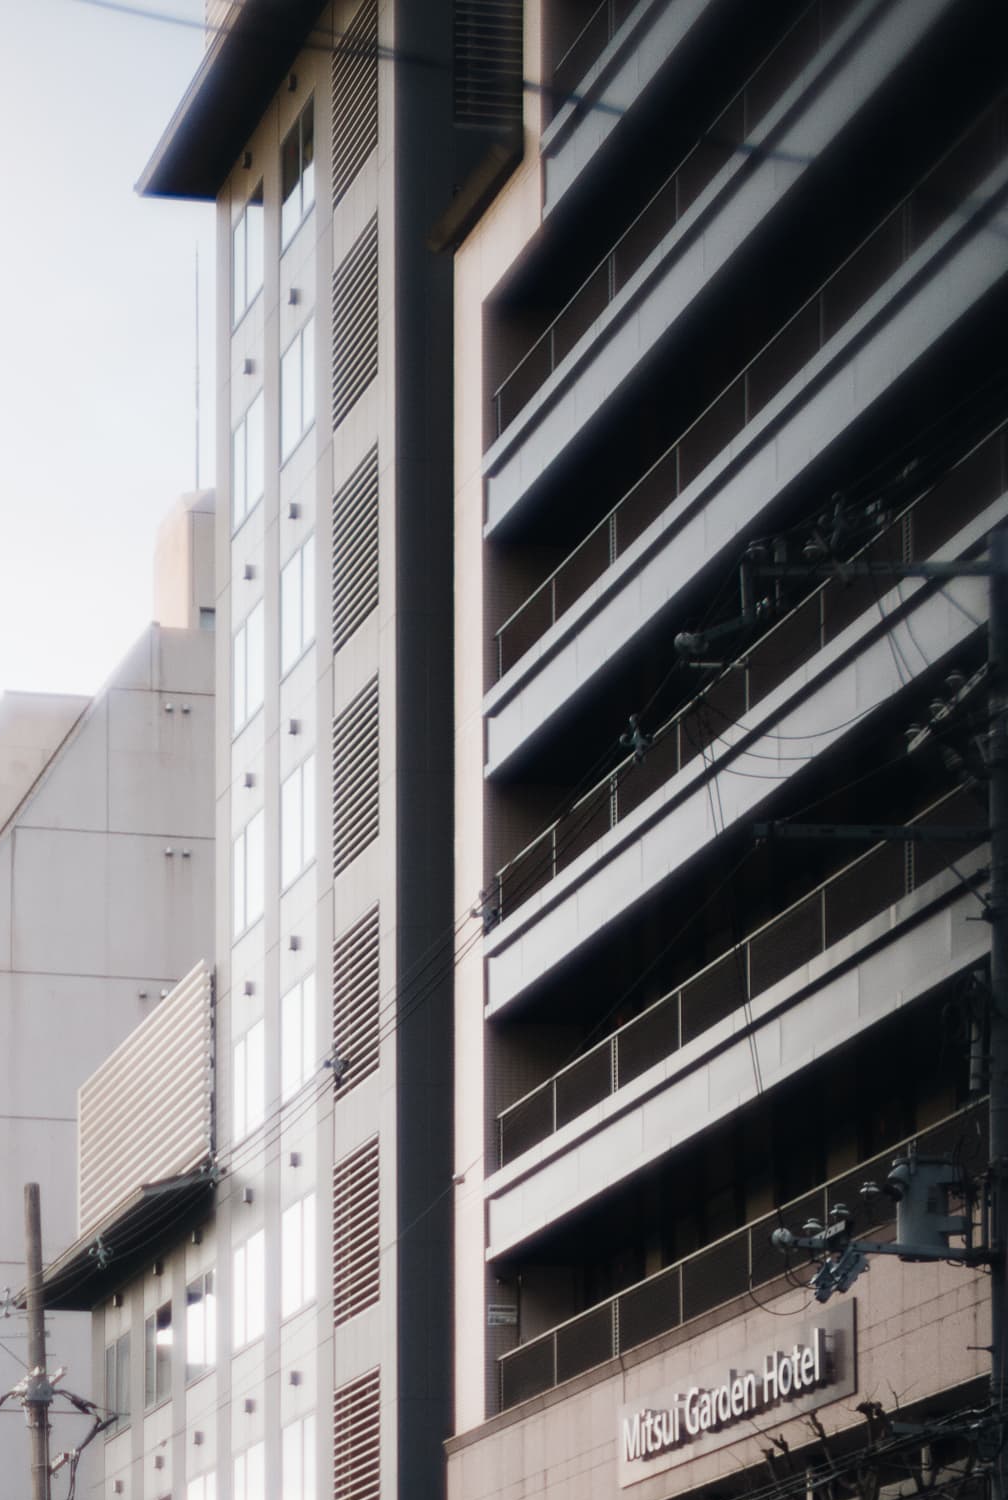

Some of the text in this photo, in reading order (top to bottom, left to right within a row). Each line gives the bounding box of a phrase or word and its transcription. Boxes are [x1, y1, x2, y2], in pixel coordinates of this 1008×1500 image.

[623, 1327, 822, 1462] Mitsui Garden Hotel
